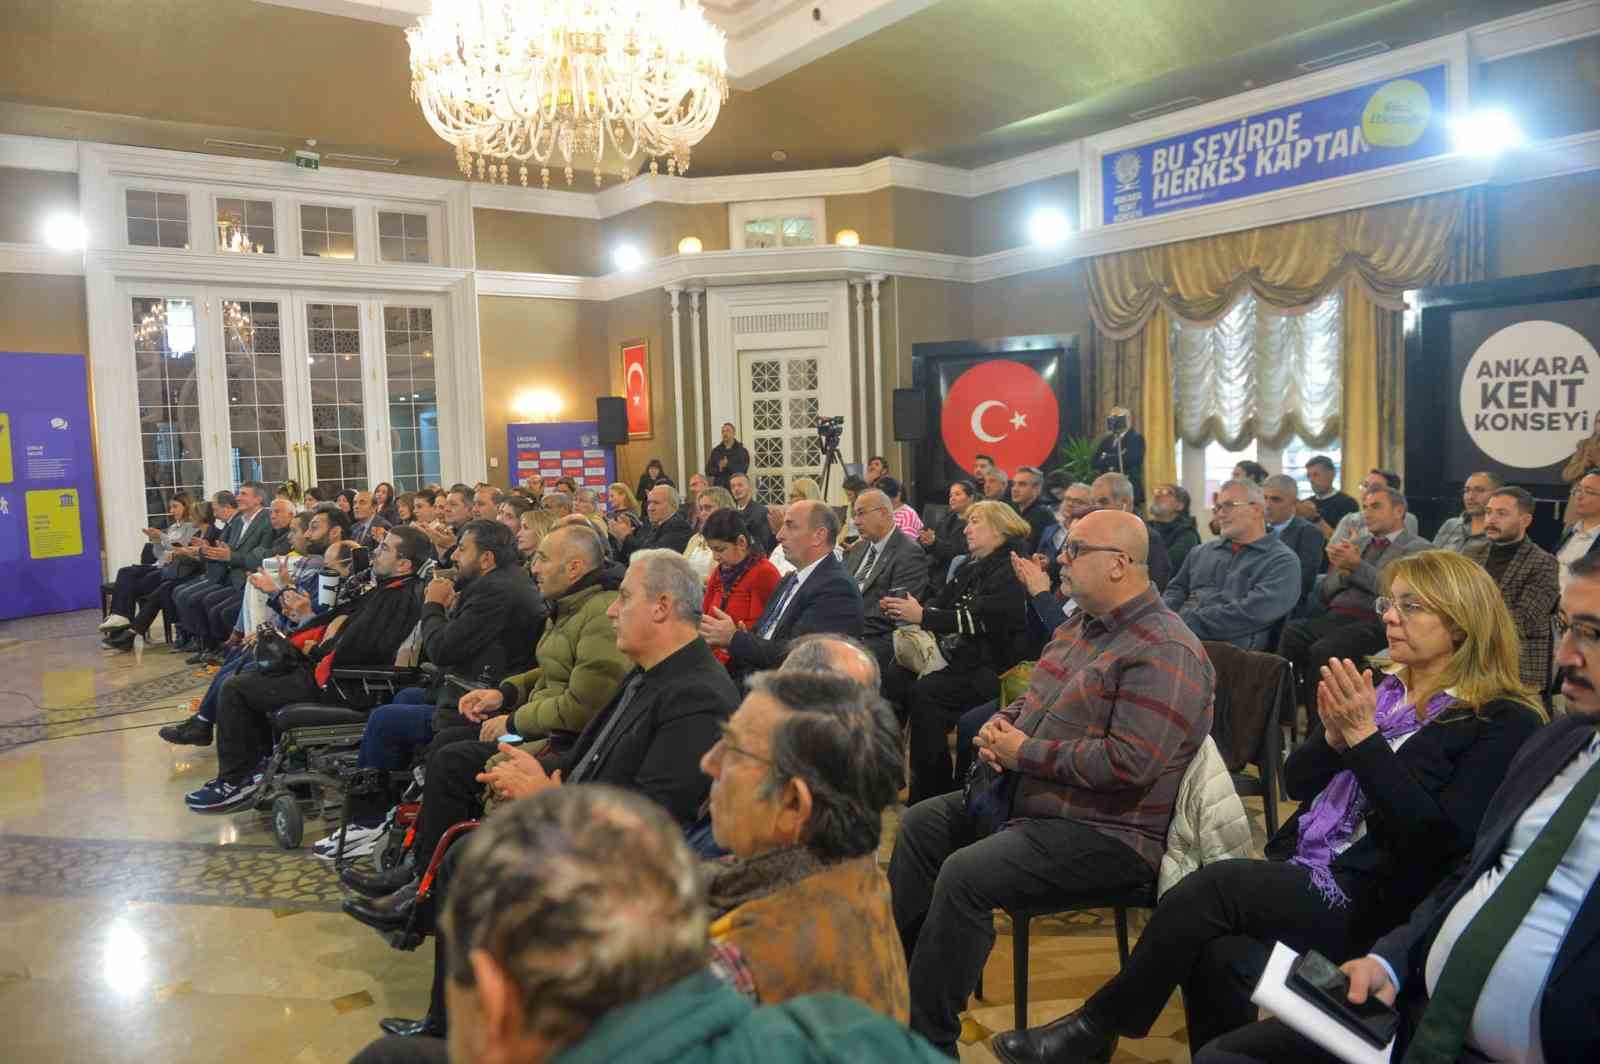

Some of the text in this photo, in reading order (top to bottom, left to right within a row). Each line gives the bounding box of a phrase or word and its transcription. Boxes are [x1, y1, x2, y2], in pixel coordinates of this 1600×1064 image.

[1152, 112, 1303, 175] BU SEYİRDE
[1152, 153, 1248, 200] HERKES
[1476, 355, 1590, 379] ANKARA
[1481, 378, 1585, 410] KENT
